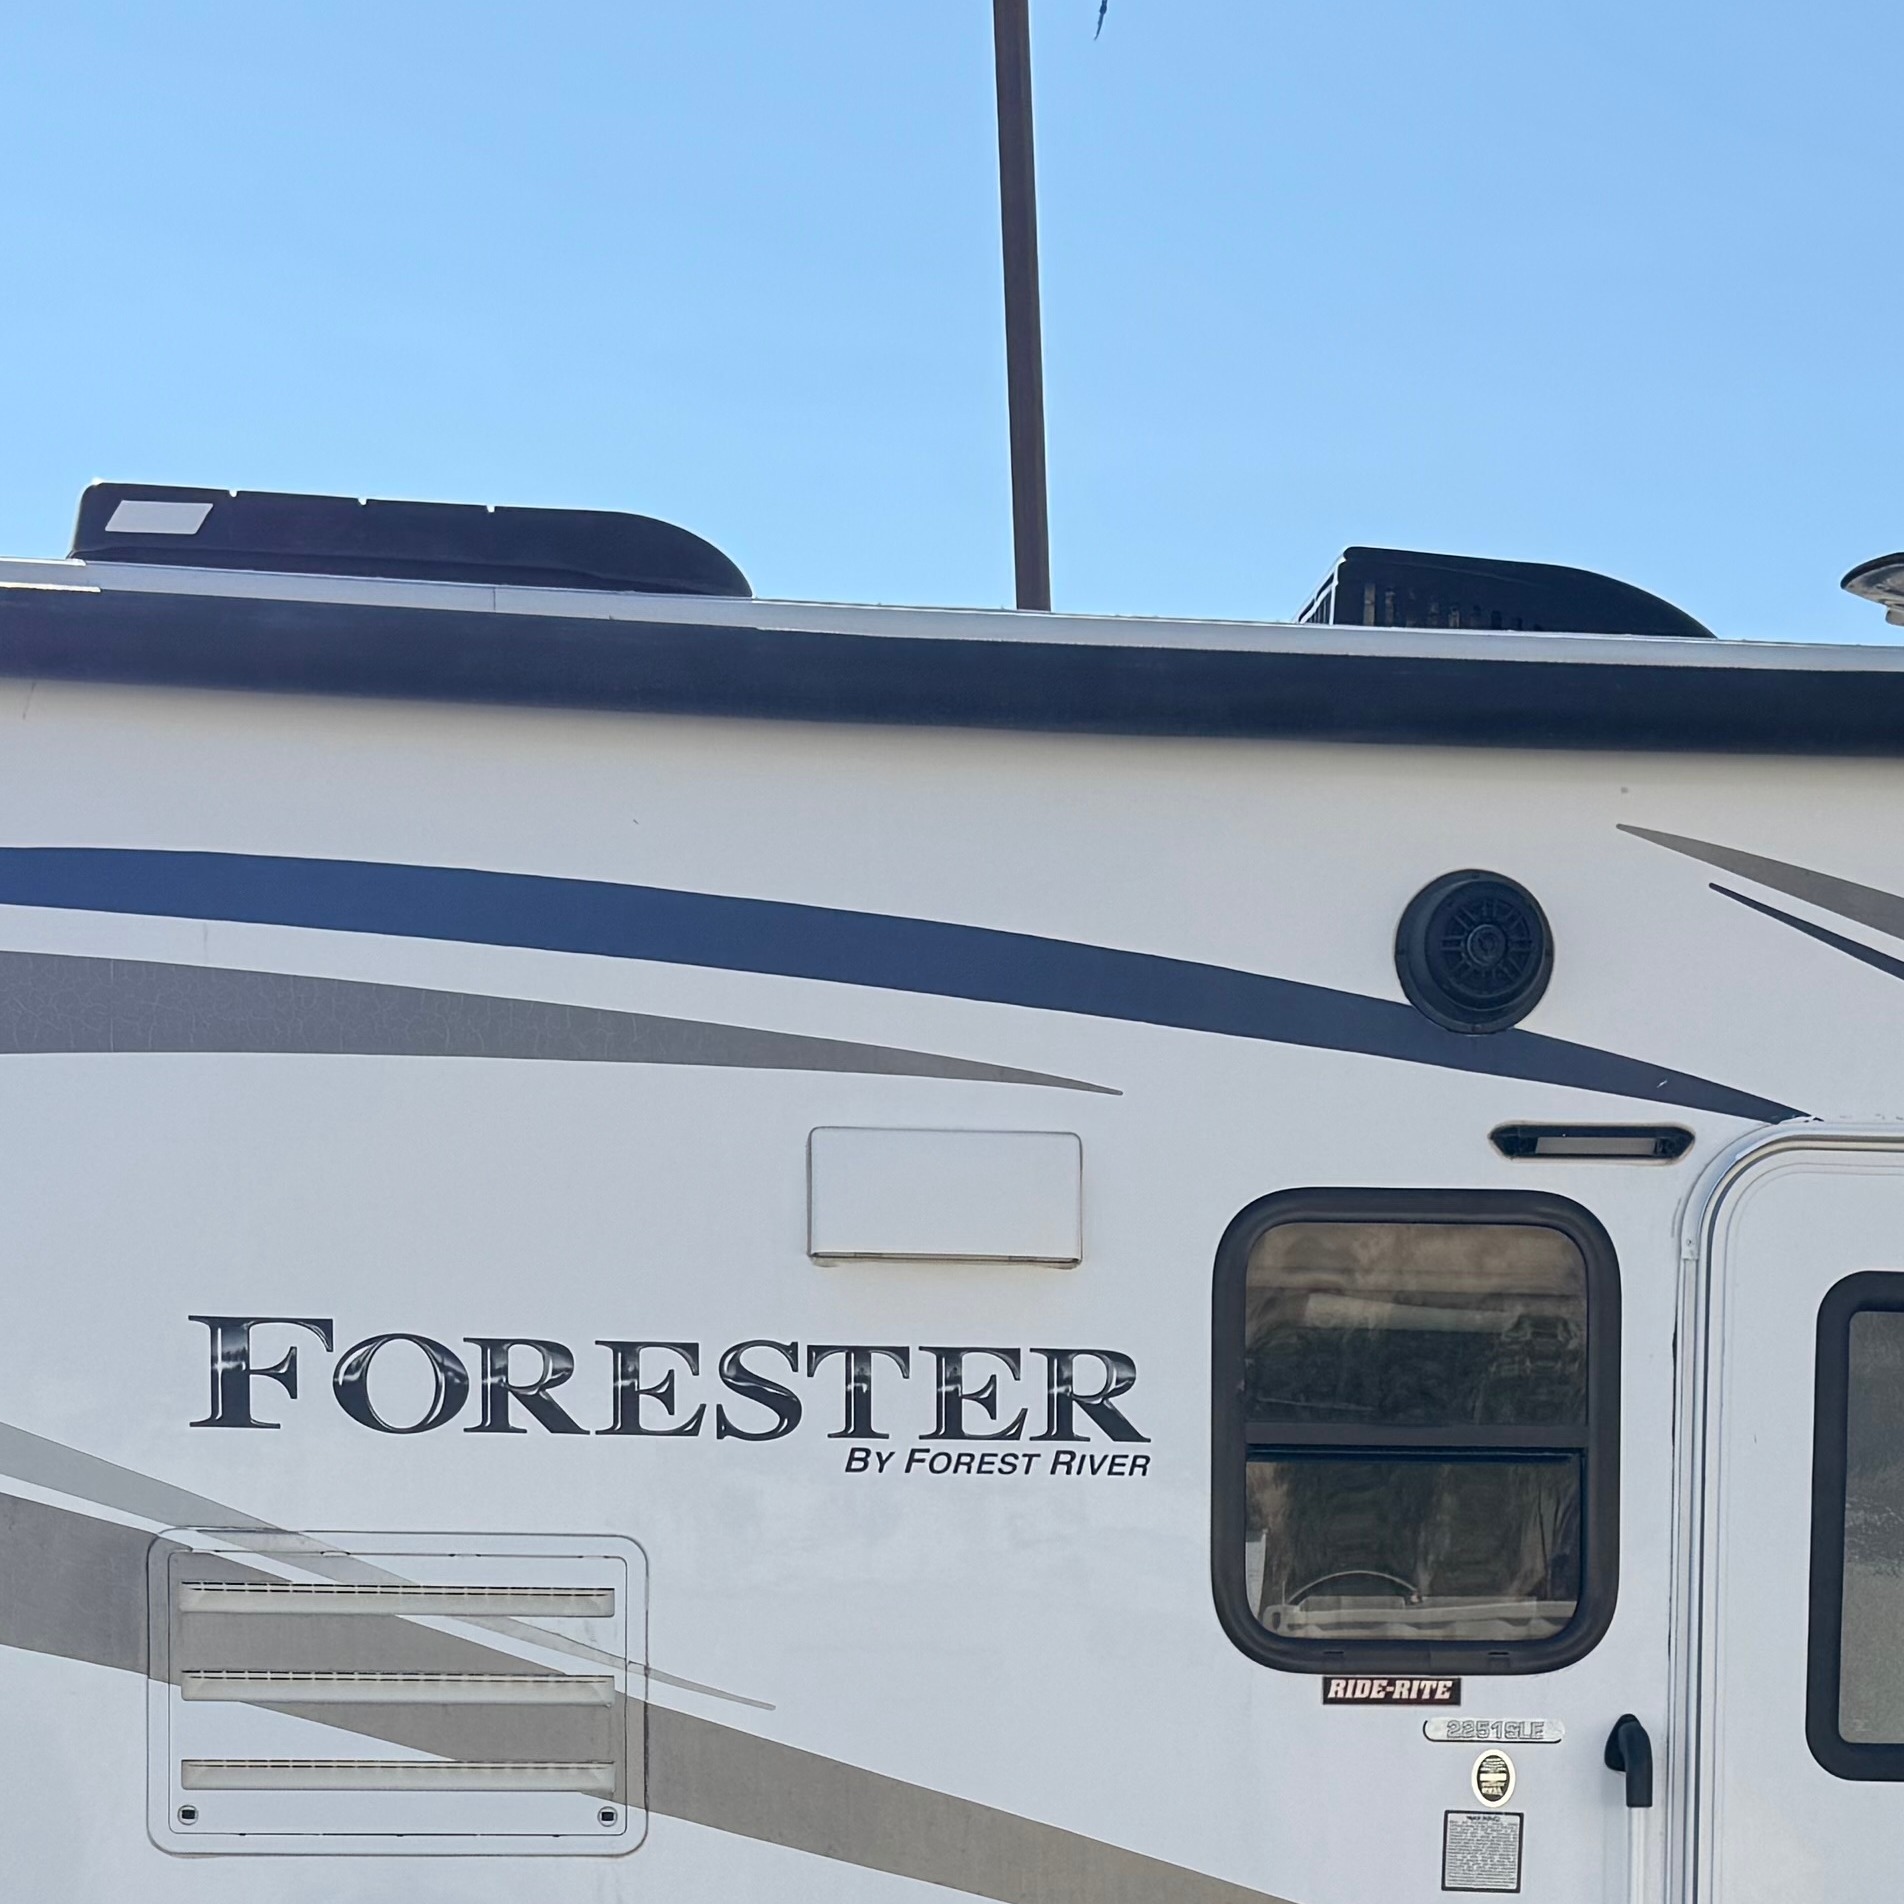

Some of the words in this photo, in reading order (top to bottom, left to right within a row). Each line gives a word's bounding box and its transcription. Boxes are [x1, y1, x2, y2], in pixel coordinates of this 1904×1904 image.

[187, 1315, 1152, 1443] FORESTER
[844, 1447, 896, 1474] BY
[903, 1448, 1042, 1475] FOREST
[1049, 1449, 1152, 1477] RIVER
[1327, 1679, 1453, 1700] RIDE-RITE
